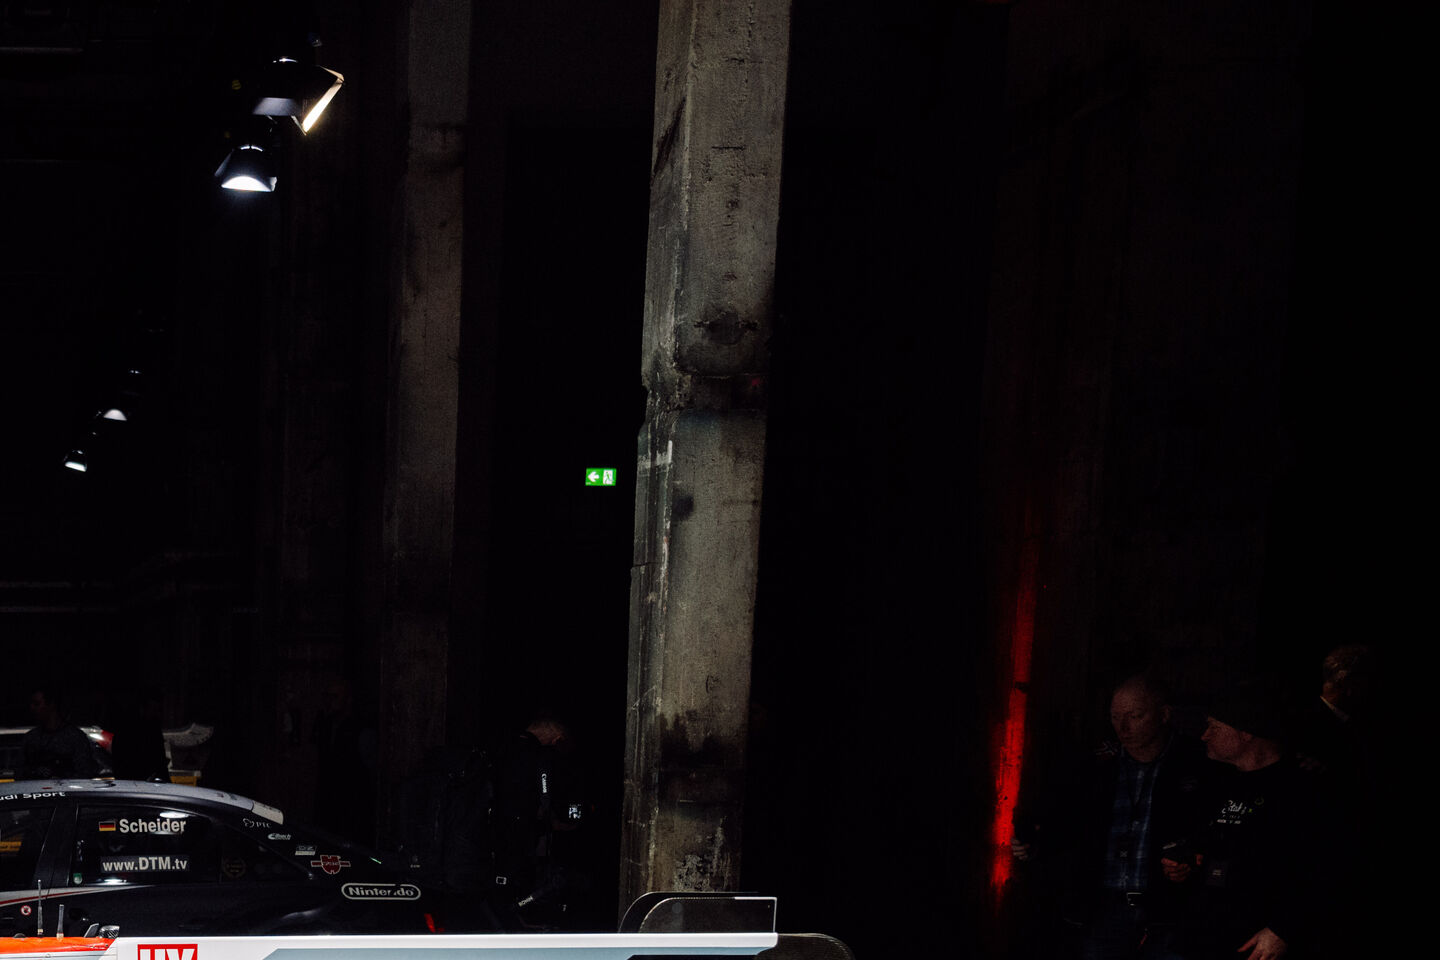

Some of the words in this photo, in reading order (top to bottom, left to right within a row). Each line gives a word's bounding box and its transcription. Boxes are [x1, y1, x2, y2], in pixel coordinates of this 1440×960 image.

[22, 791, 66, 800] Sport
[119, 818, 187, 834] Scheider
[102, 856, 188, 872] www.DTM.tv
